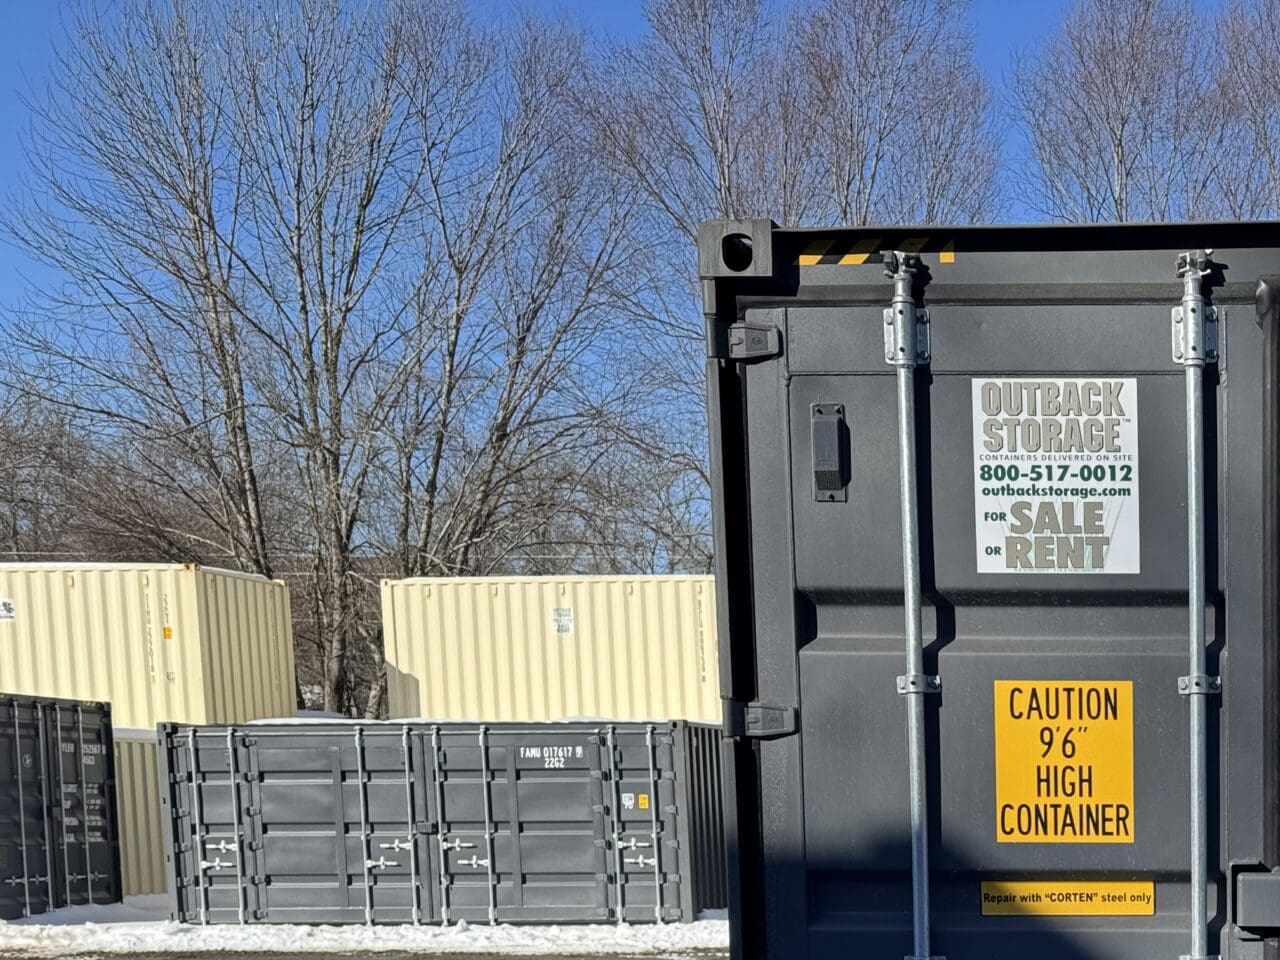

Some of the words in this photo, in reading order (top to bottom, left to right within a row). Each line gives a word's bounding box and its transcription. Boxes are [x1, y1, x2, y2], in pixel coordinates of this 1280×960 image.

[981, 381, 1126, 417] OUTBACK
[982, 417, 1121, 453] STORAGE
[980, 464, 1132, 482] 800-517-0012
[982, 484, 1131, 498] outbackstorage.com
[984, 512, 1007, 521] FOR
[1010, 501, 1104, 535] SALE
[985, 546, 1002, 556] OR
[1005, 536, 1110, 569] RENT
[1009, 687, 1118, 720] CAUTION
[543, 747, 573, 758] 017617
[544, 758, 565, 768] 22G2
[1036, 765, 1093, 797] HIGH
[1000, 804, 1129, 836] CONTAINER
[983, 893, 1016, 904] Repair
[1020, 893, 1042, 902] with
[1045, 893, 1099, 902] "CORTEN"
[1101, 893, 1126, 902] steel
[1130, 893, 1151, 904] only
